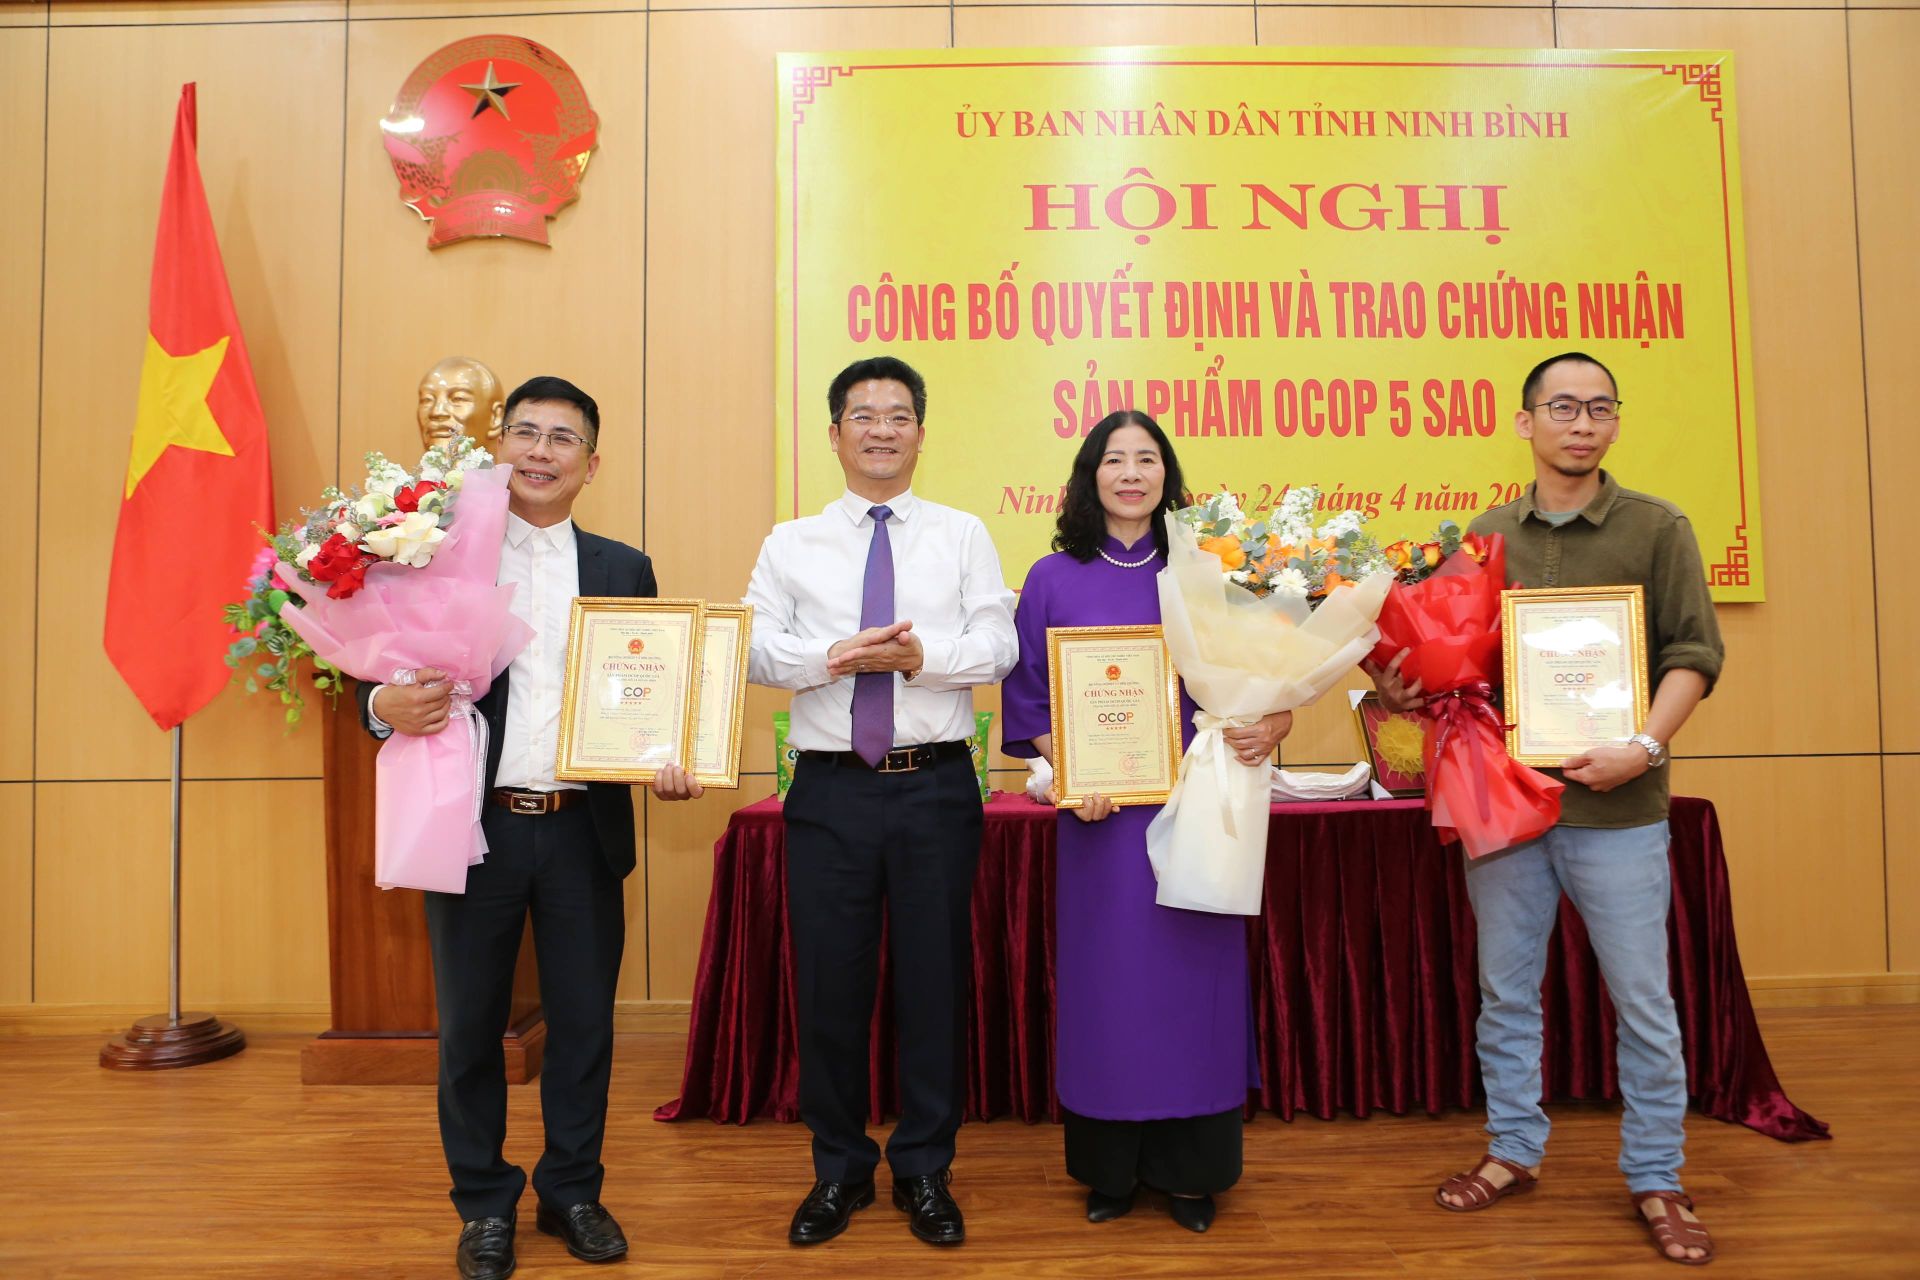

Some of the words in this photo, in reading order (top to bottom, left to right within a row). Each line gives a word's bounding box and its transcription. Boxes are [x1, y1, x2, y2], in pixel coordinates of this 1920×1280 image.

[955, 104, 1006, 138] ỦY
[1012, 110, 1086, 137] BAN
[1094, 101, 1197, 137] NHÂN
[1206, 101, 1280, 137] DÂN
[1289, 101, 1377, 138] TỈNH
[1385, 110, 1475, 138] NINH
[1482, 103, 1570, 138] BÌNH
[1023, 167, 1219, 245] HỘI
[1240, 183, 1511, 246] NGHỊ
[848, 272, 956, 343] CÔNG
[967, 261, 1020, 341] BỐ
[1031, 262, 1154, 346] QUYẾT
[1164, 281, 1261, 352] ĐỊNH
[1269, 269, 1322, 338] VÀ
[1329, 281, 1427, 339] TRAO
[1437, 269, 1569, 339] CHỨNG
[1577, 270, 1685, 349] NHẬN
[1053, 359, 1135, 439] SẢN
[1146, 354, 1263, 438] PHẨM
[1273, 378, 1378, 439] OCOP
[1389, 379, 1412, 438] 5
[1421, 378, 1498, 438] SAO
[1389, 483, 1408, 512] 4
[1414, 482, 1479, 512] năm
[623, 687, 651, 697] COP
[1554, 673, 1594, 683] OCOP
[1098, 712, 1134, 722] OCOP
